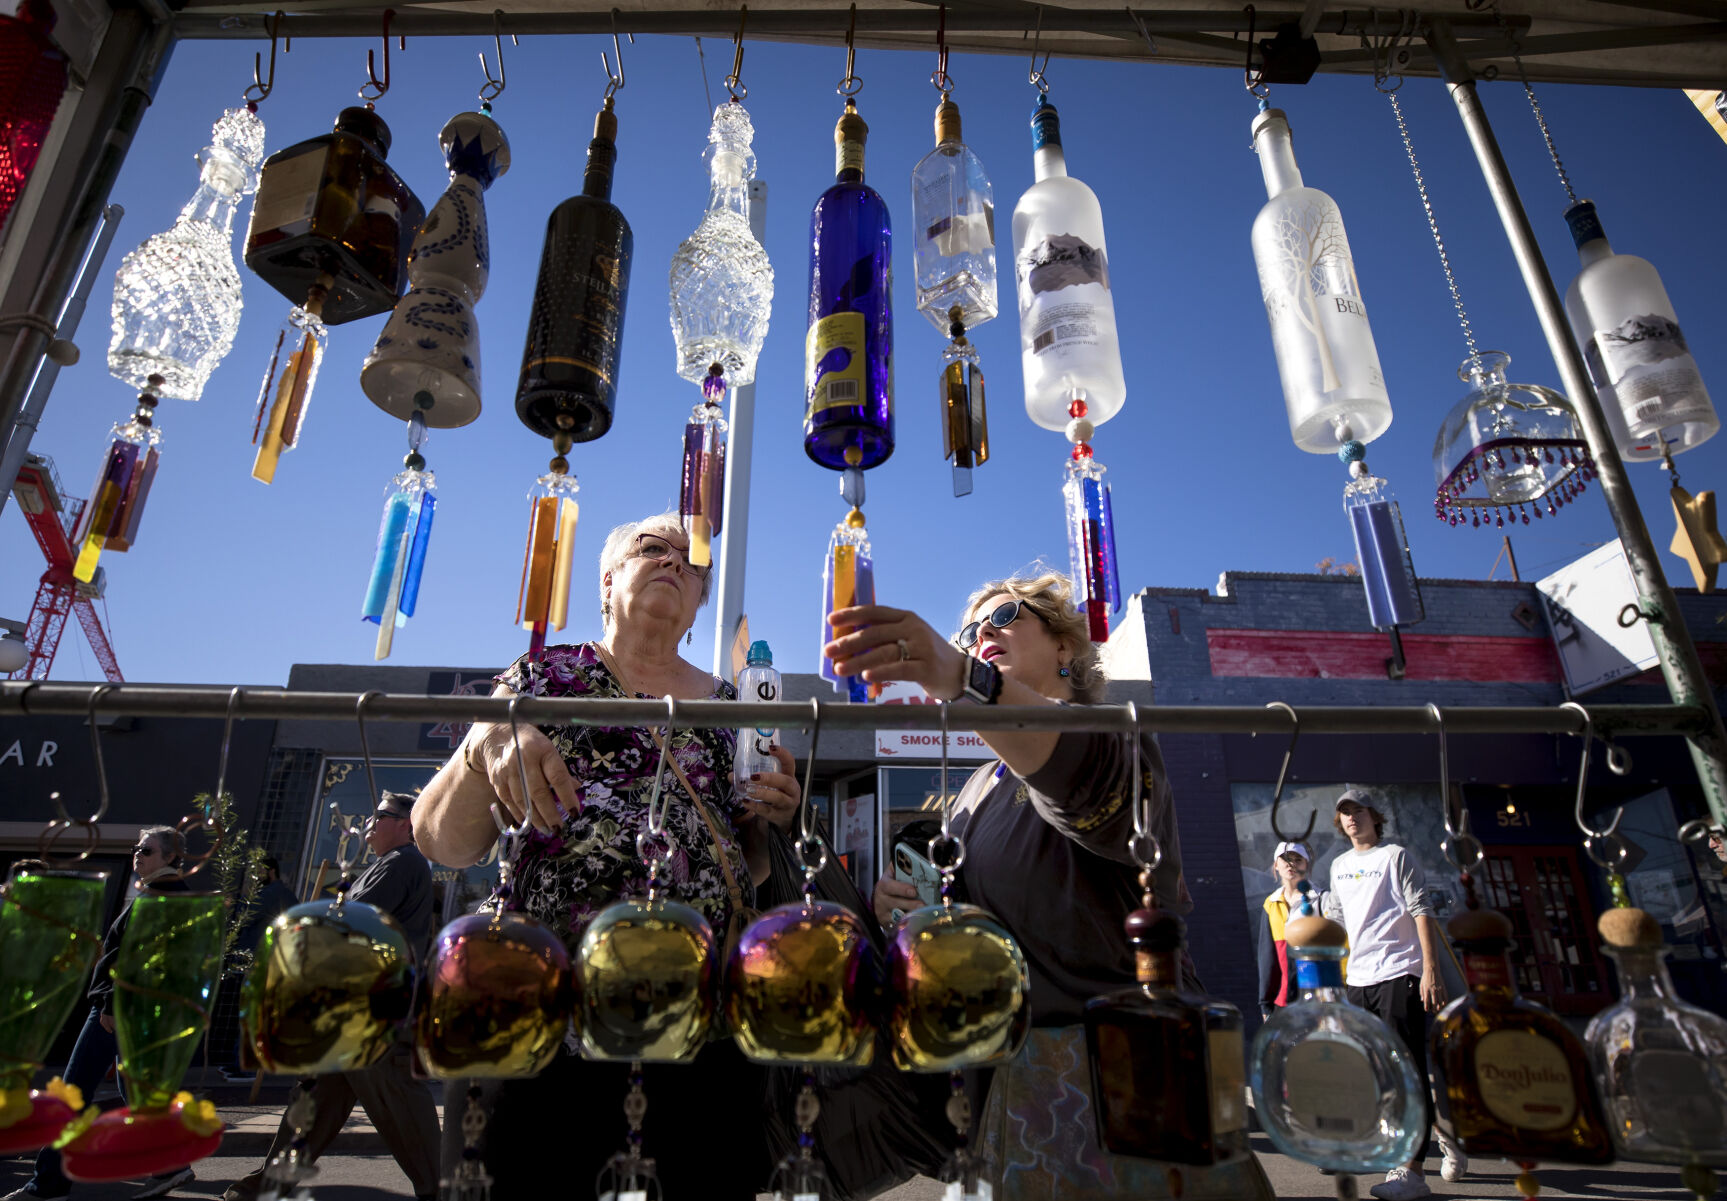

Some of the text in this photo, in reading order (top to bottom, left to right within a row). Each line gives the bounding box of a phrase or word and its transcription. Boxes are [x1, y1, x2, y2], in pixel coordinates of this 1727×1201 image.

[1603, 668, 1621, 680] 521
[755, 681, 777, 756] ce
[901, 735, 986, 747] SMOKE SHO
[0, 739, 58, 767] AR
[1496, 810, 1531, 827] 521
